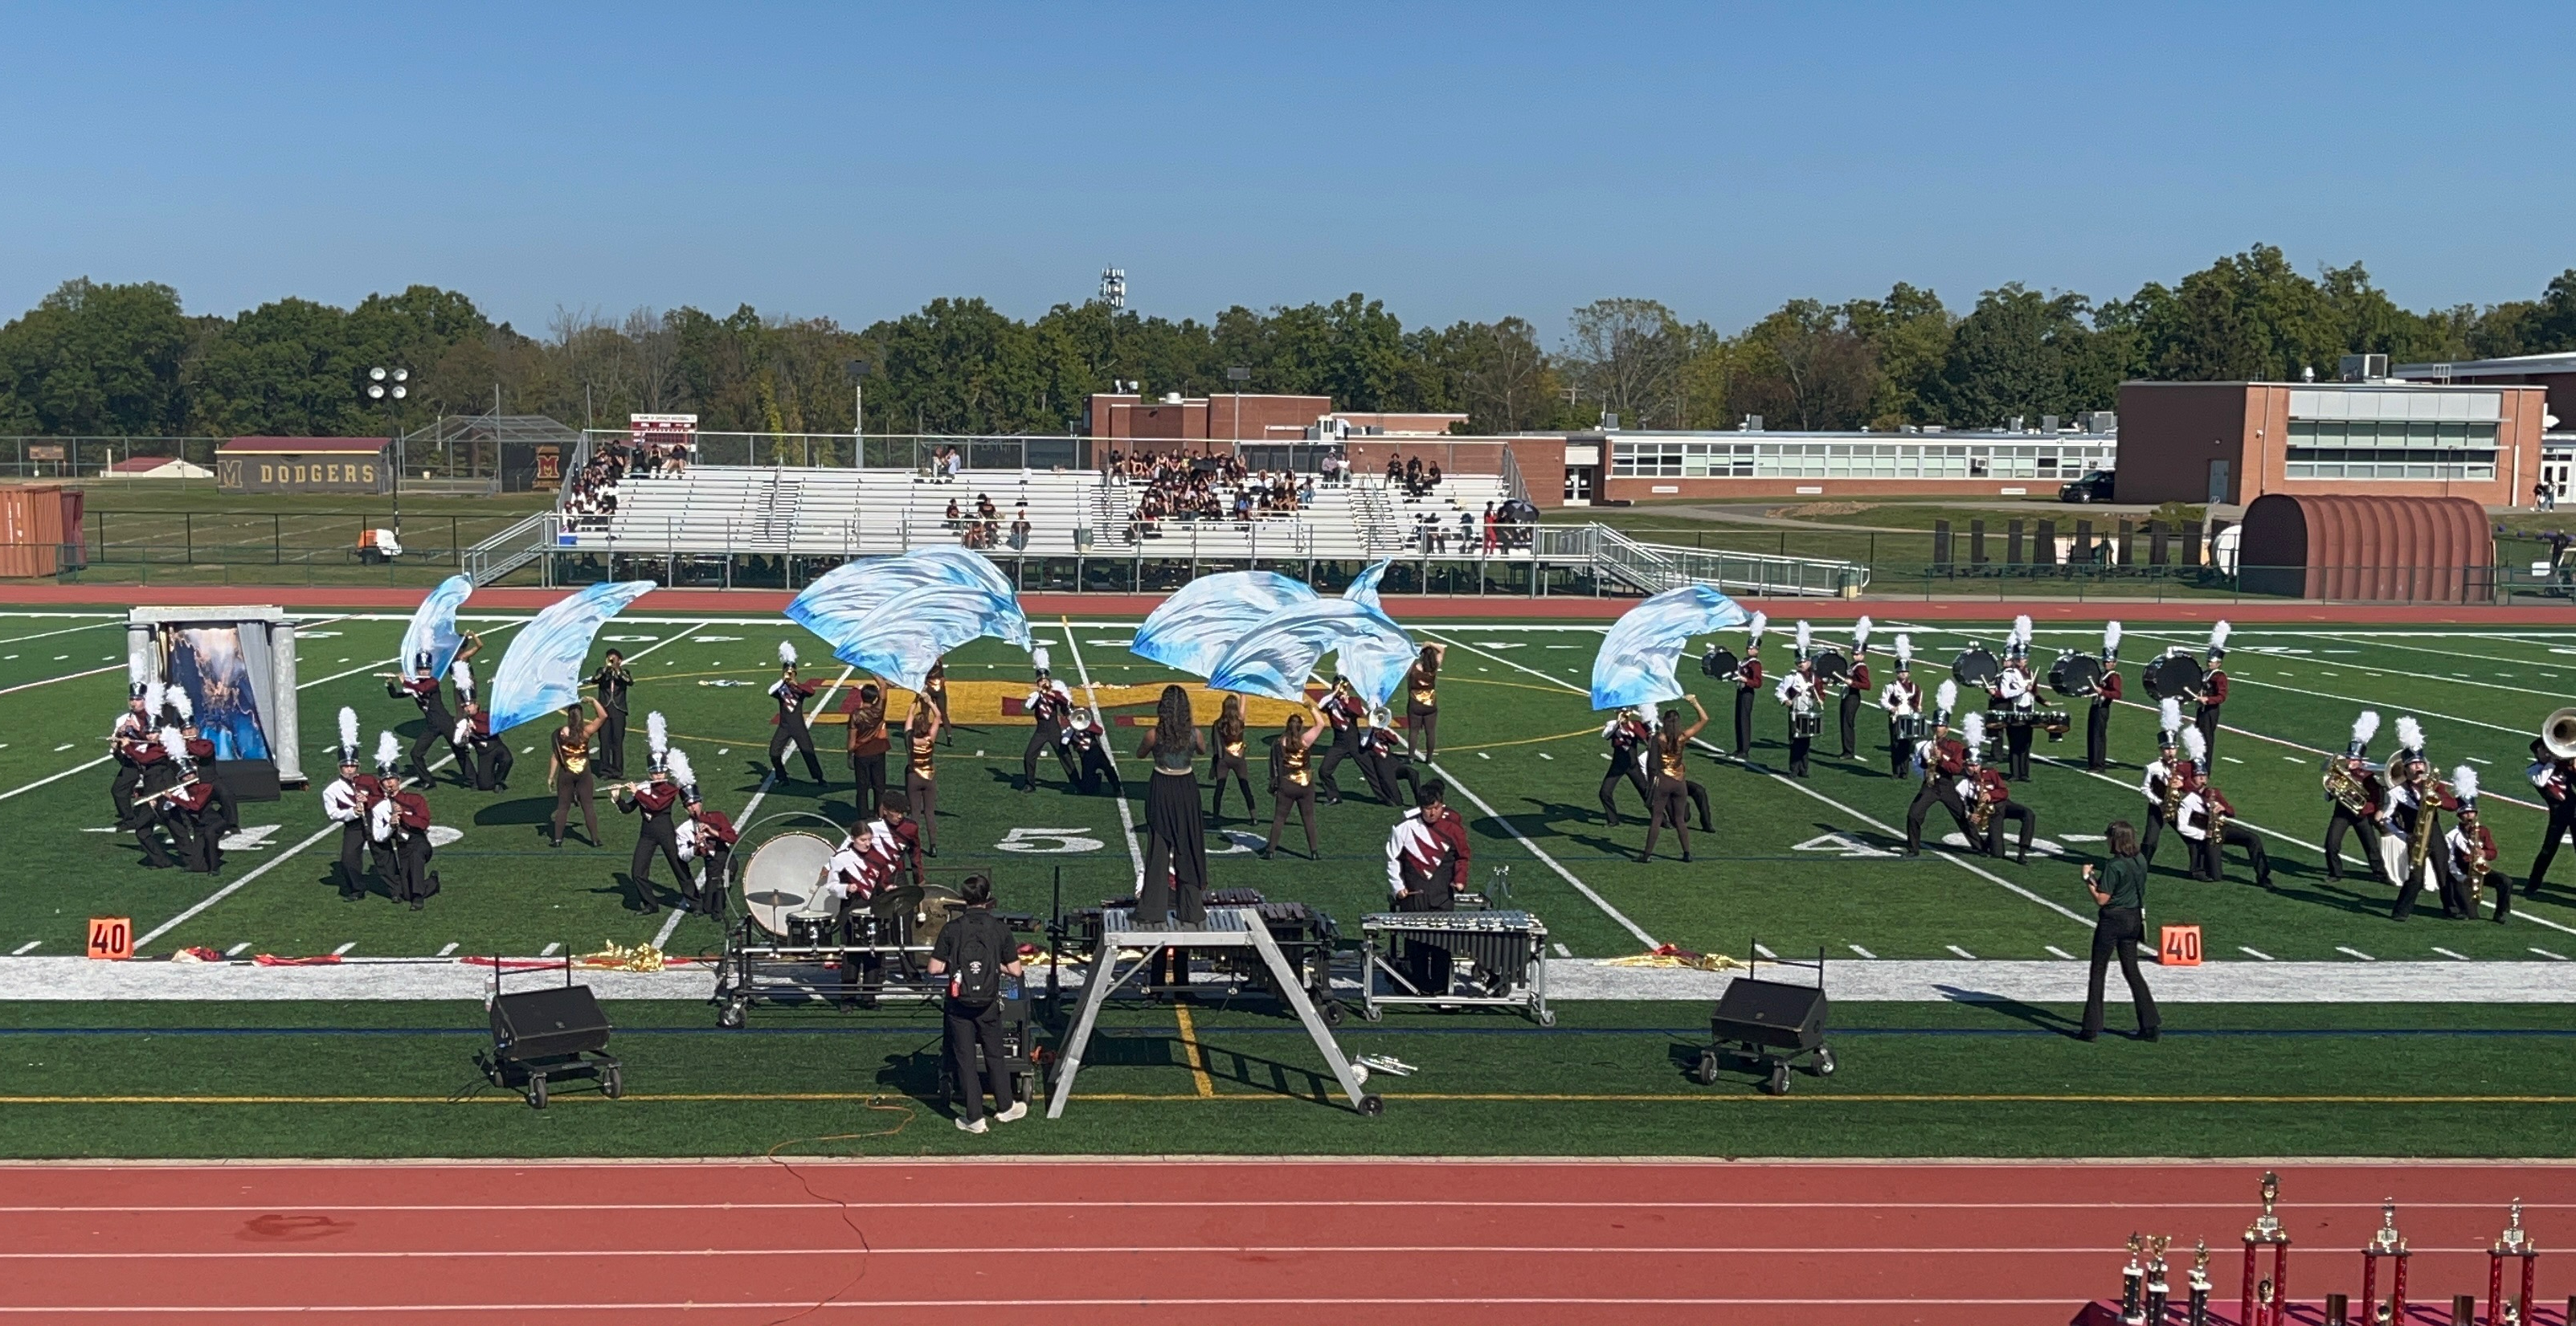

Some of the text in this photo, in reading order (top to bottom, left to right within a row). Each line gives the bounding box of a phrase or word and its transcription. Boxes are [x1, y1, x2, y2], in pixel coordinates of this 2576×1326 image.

[217, 460, 374, 489] M DODGERS
[536, 455, 560, 479] M
[994, 827, 1105, 853] 5
[92, 923, 125, 954] 40
[2166, 931, 2198, 960] 40
